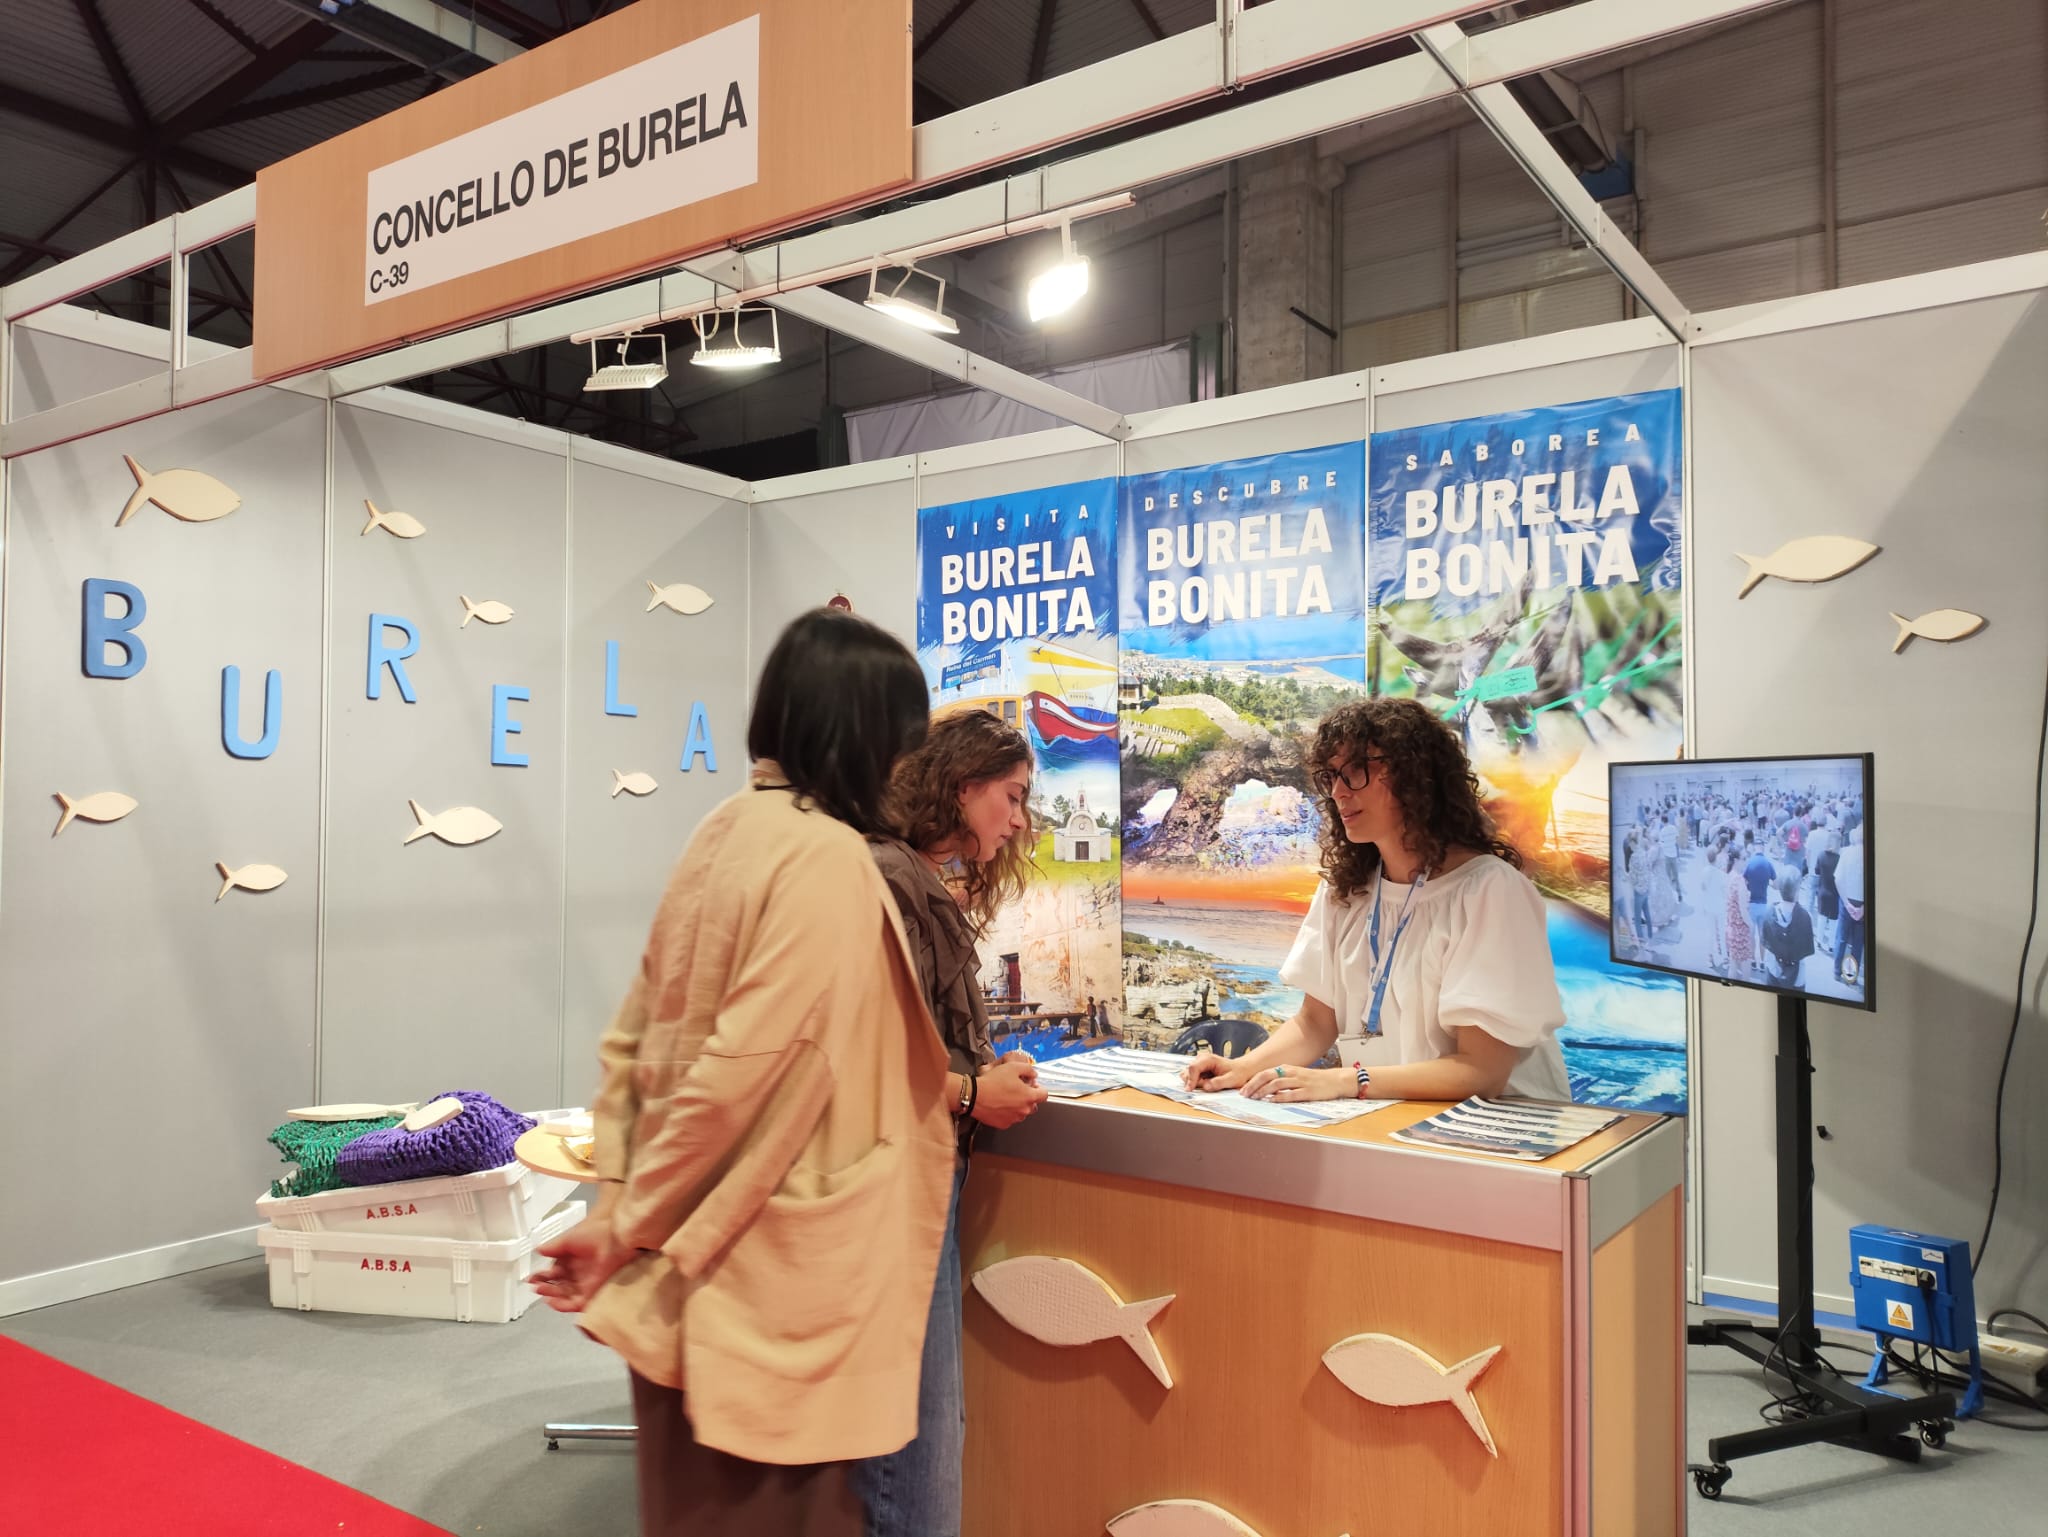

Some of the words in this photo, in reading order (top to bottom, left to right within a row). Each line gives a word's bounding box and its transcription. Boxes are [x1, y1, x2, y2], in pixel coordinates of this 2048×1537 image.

[373, 160, 535, 255] CONCELLO
[543, 138, 588, 197] DE
[598, 80, 748, 179] BURELA
[370, 261, 409, 293] C-39
[1406, 424, 1641, 471] SABOREA
[1145, 471, 1336, 511] DESCUBRE
[1405, 465, 1640, 538] BURELA
[946, 505, 1089, 538] VISITA
[1147, 508, 1332, 571] BURELA
[941, 536, 1095, 594] BURELA
[1405, 528, 1640, 600] BONITA
[942, 587, 1095, 645] BONITA
[1148, 565, 1332, 626] BONITA
[366, 1203, 417, 1219] A.B.S.A
[361, 1258, 412, 1272] A.B.S.A
